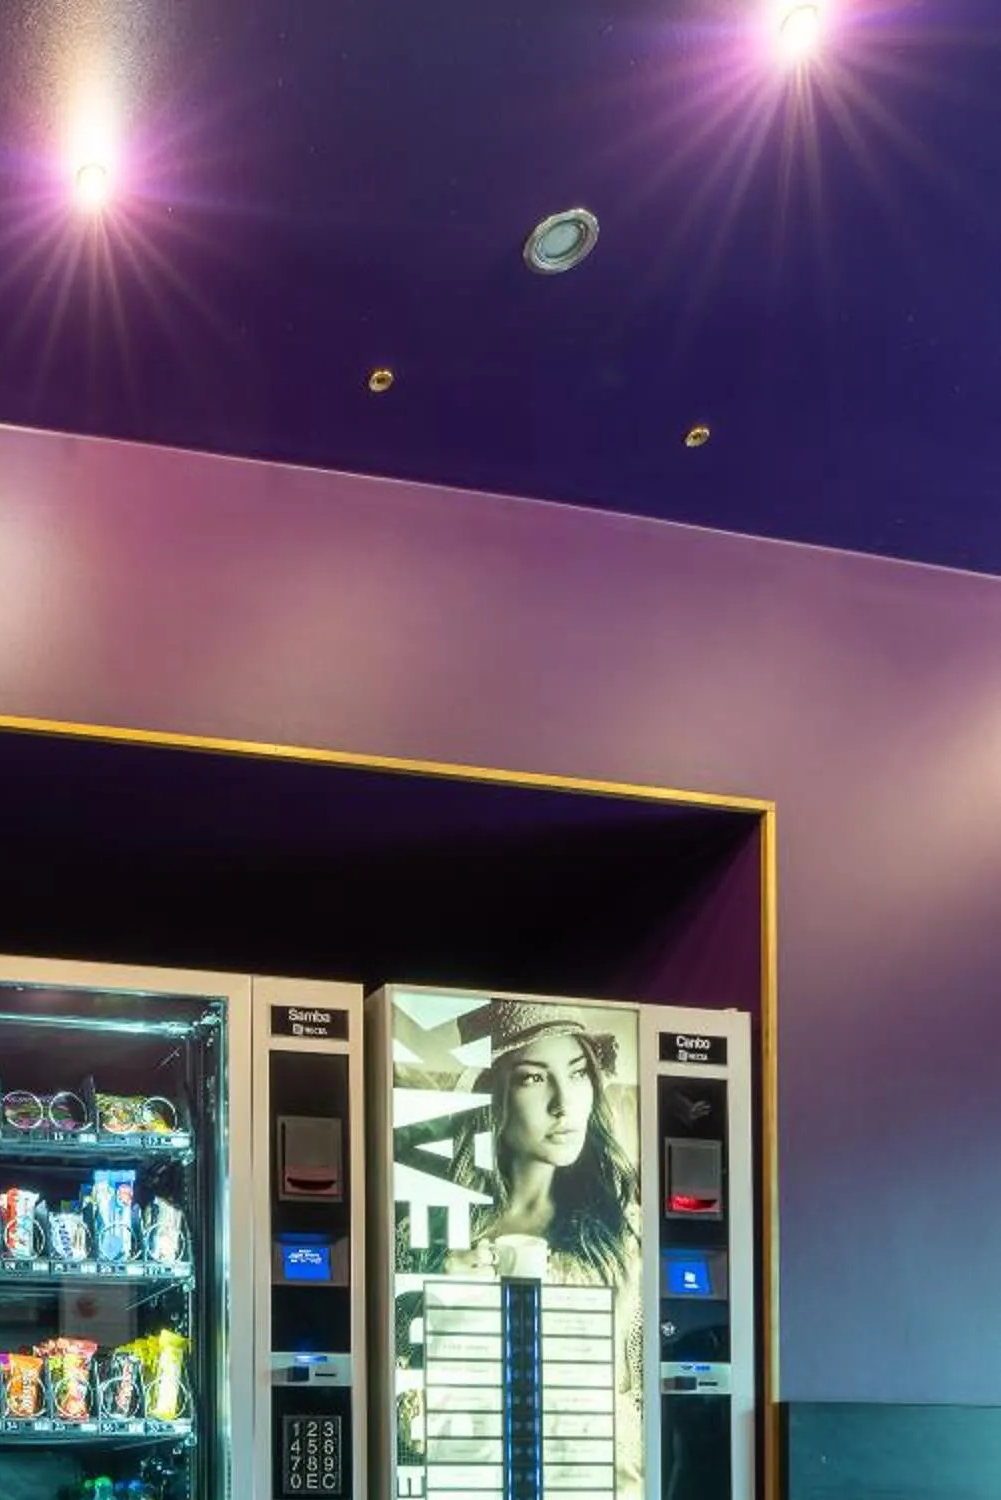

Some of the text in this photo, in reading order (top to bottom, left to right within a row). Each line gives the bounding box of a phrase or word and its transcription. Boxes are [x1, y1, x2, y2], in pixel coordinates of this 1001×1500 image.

[288, 1008, 331, 1023] Samba
[307, 1421, 318, 1437] 2
[323, 1421, 334, 1437] 3
[291, 1440, 334, 1454] 4 5 6
[291, 1456, 334, 1471] 7 8 9
[307, 1473, 318, 1489] E
[323, 1473, 336, 1489] C
